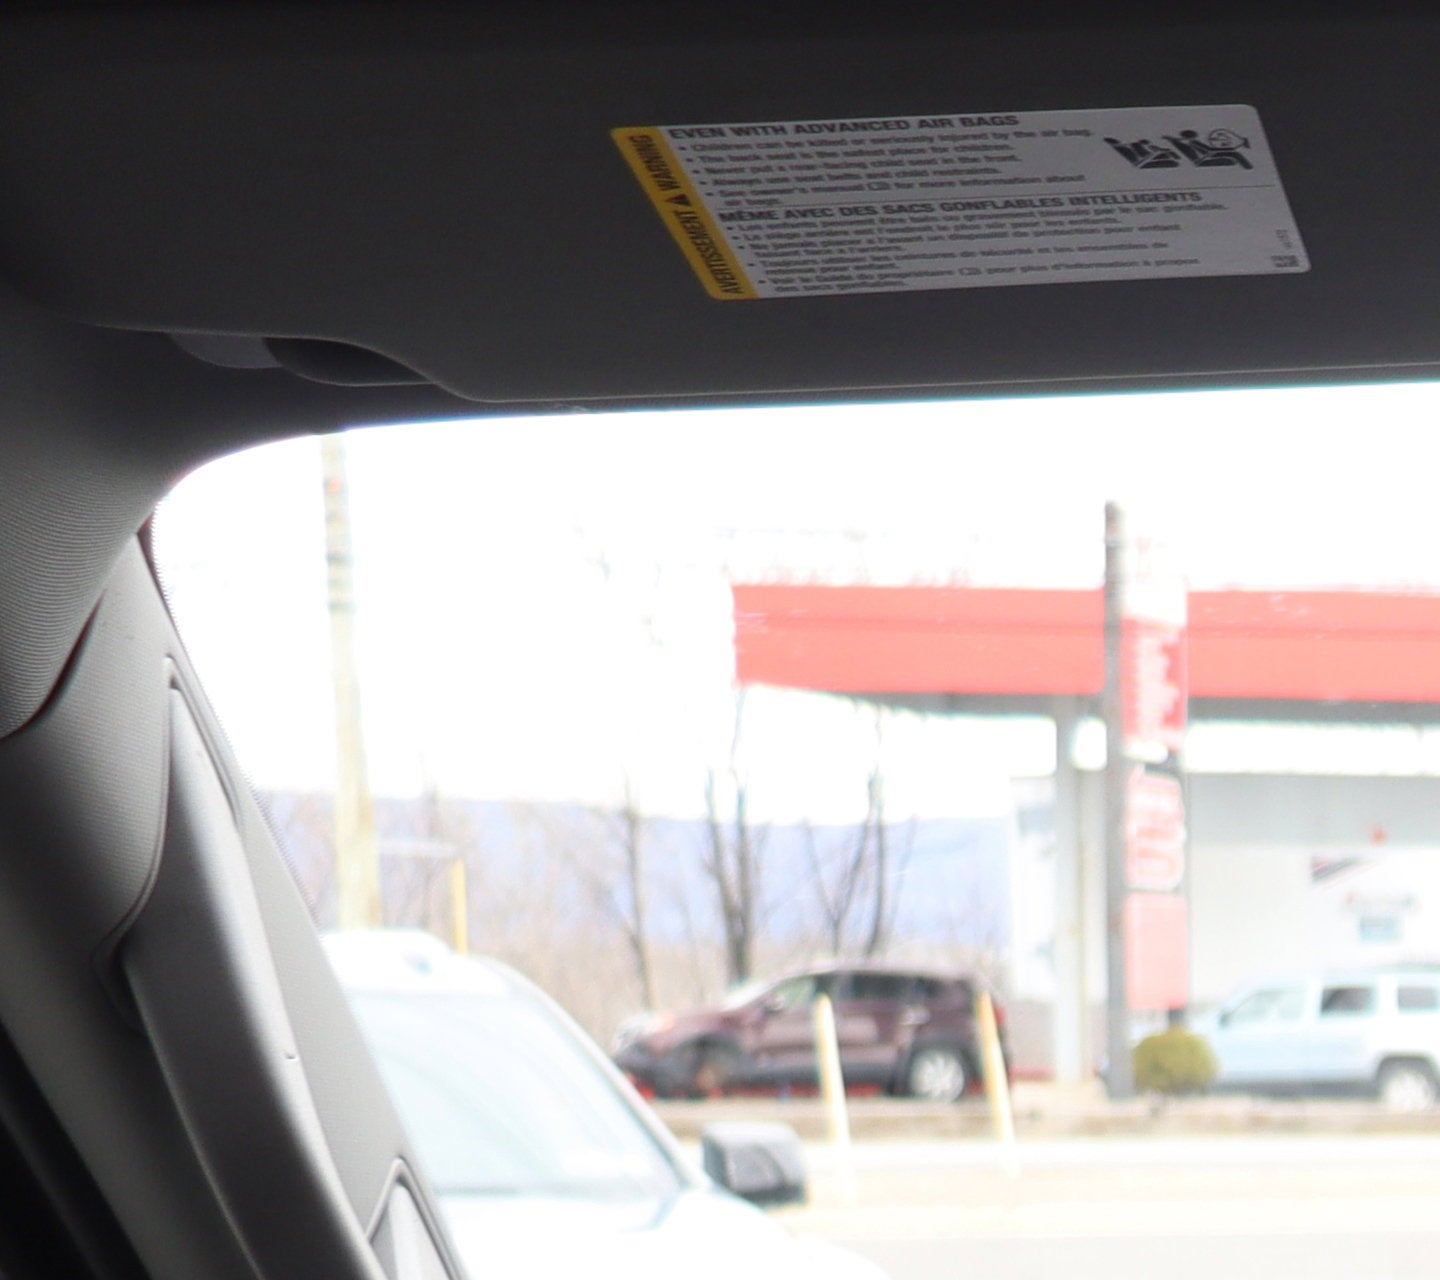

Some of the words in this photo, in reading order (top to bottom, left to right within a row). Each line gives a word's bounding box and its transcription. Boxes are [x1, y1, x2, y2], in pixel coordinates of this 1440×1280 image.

[668, 127, 725, 139] EVEN
[729, 124, 786, 136] WITH
[794, 119, 911, 135] ADVANCED
[917, 117, 955, 130] AIR
[960, 115, 1020, 128] BAGS
[629, 135, 681, 191] WARNING
[784, 207, 833, 219] AVEC
[839, 205, 877, 217] DES
[882, 202, 933, 215] SACS
